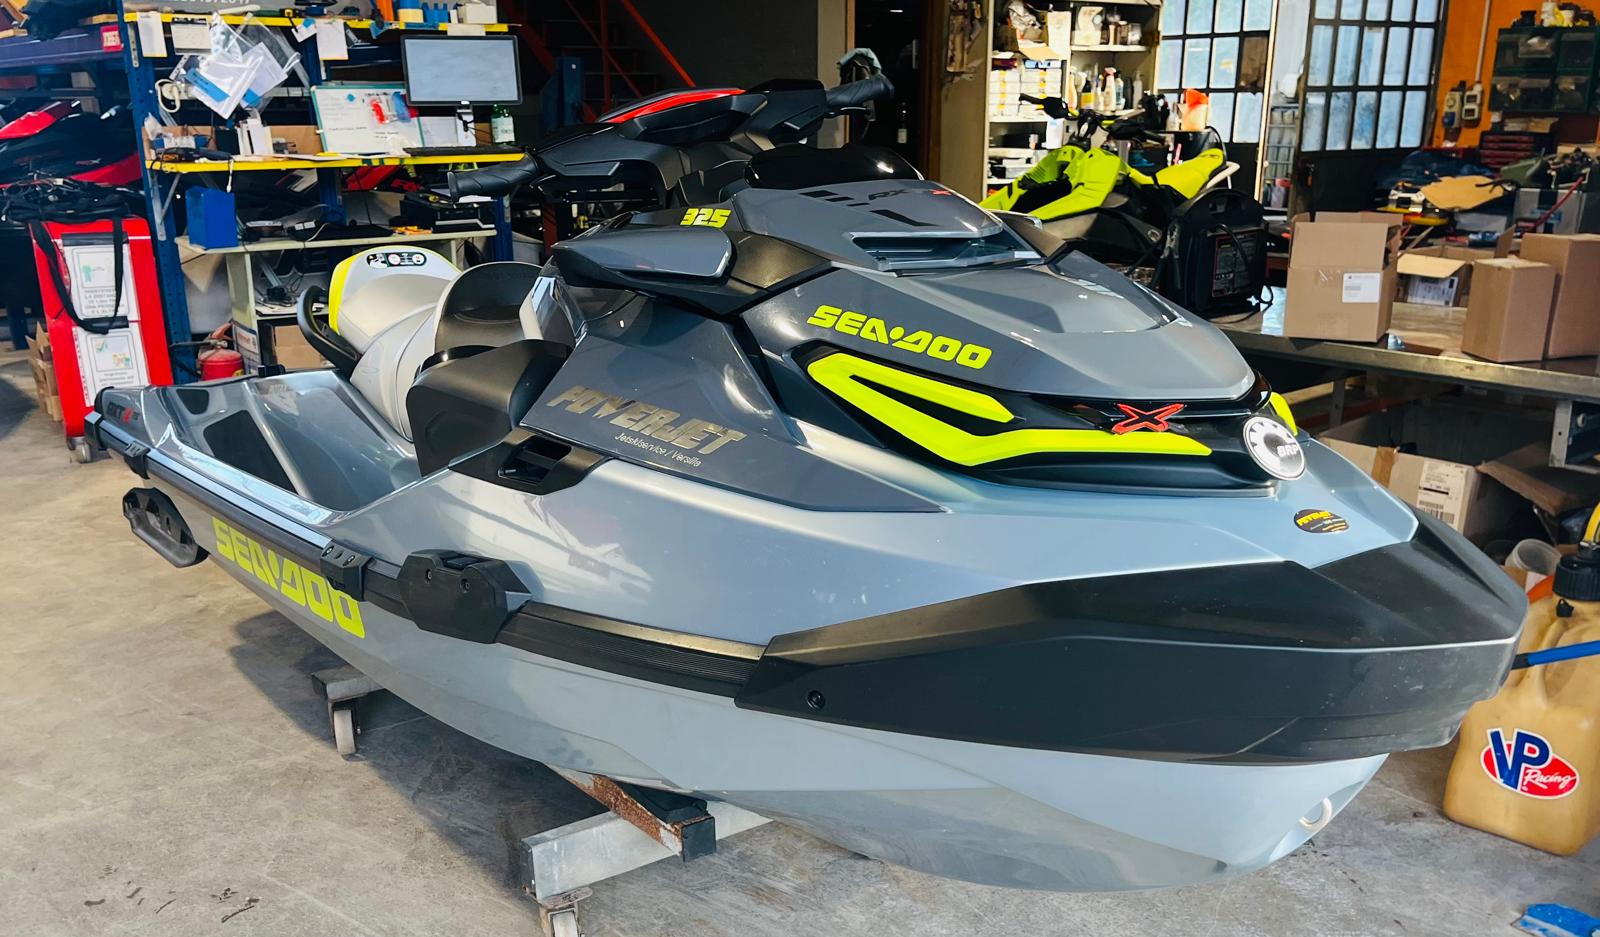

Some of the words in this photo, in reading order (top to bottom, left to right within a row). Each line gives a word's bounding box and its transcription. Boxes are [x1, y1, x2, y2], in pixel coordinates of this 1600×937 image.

[680, 207, 732, 229] 325
[546, 384, 748, 455] POWERJET
[1276, 444, 1299, 458] BRP
[1488, 729, 1551, 790] VP
[1521, 768, 1578, 790] Racing
